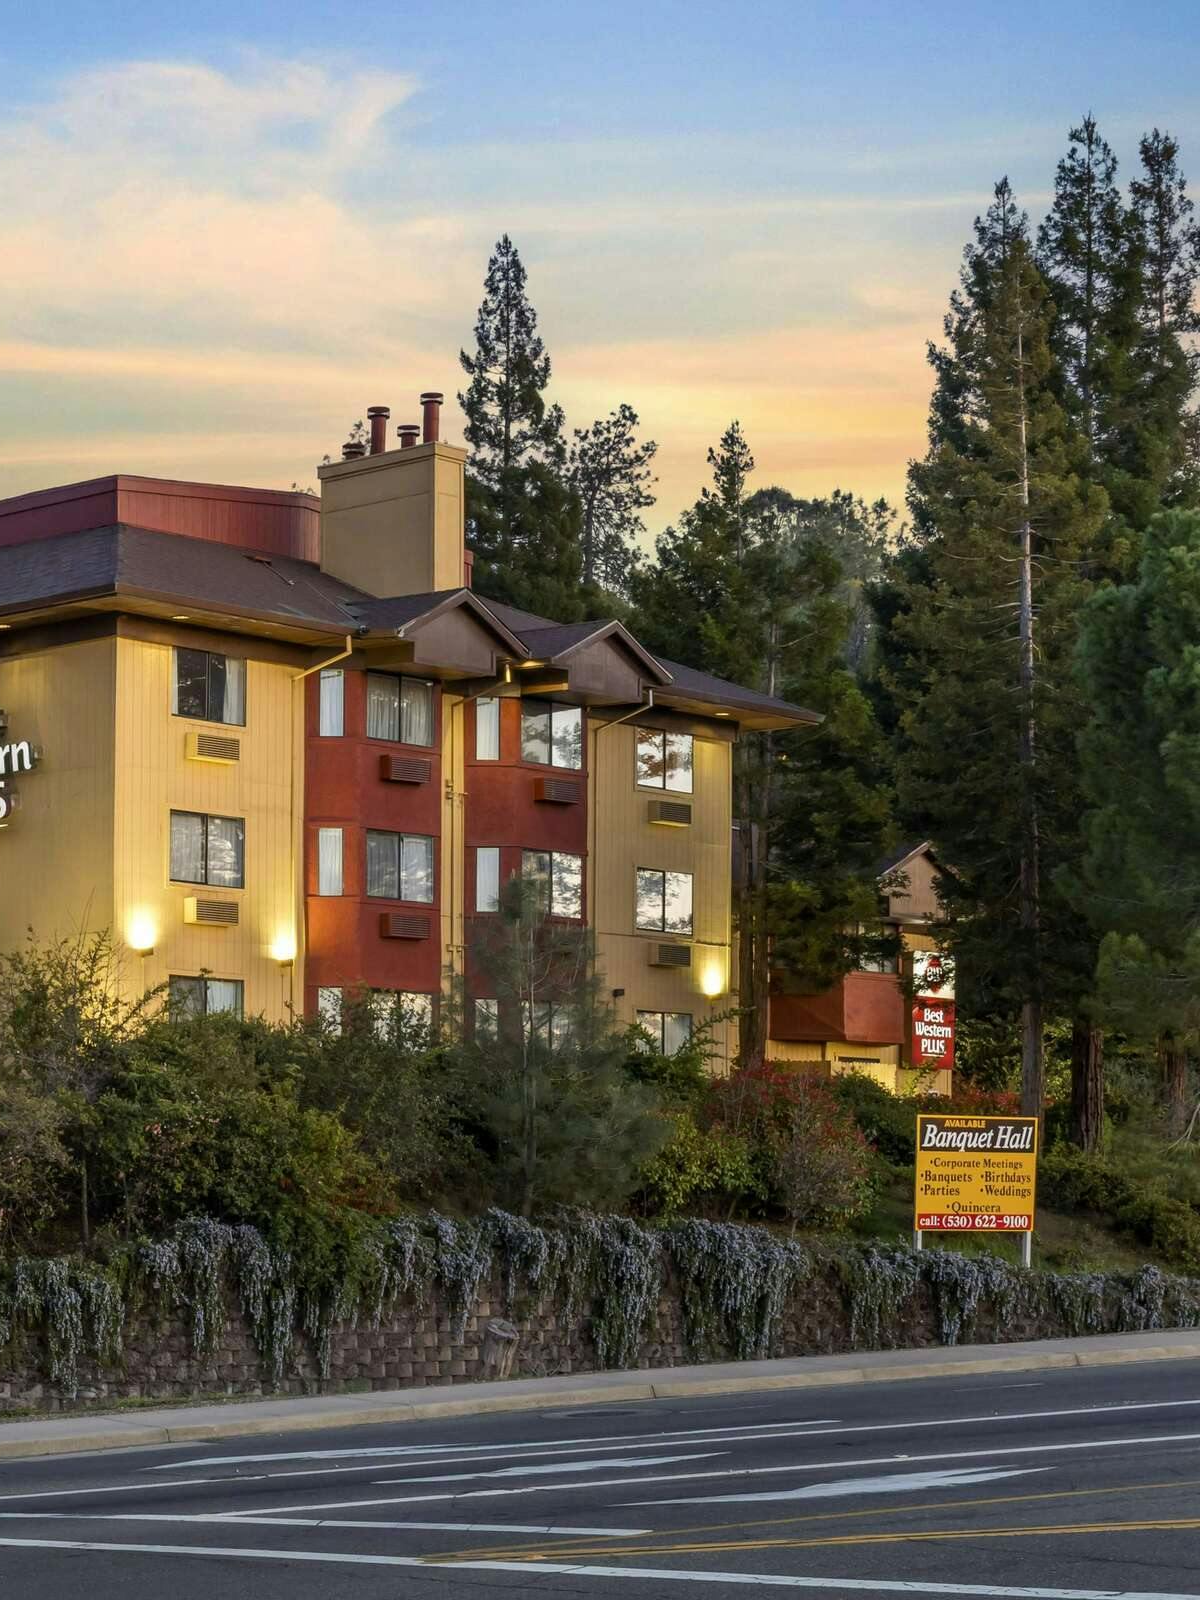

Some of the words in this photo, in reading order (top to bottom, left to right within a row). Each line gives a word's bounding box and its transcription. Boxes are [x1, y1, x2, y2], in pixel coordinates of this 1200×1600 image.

[923, 1007, 944, 1023] Best
[915, 1021, 952, 1038] Western
[921, 1038, 945, 1054] PLUS
[944, 1119, 987, 1128] AVAILABLE
[922, 1124, 994, 1152] Banquet
[994, 1126, 1033, 1149] Hall
[934, 1158, 980, 1169] Corporate
[983, 1159, 1023, 1169] Meetings
[924, 1170, 973, 1184] Banquets
[985, 1171, 1031, 1185] Birthdays
[924, 1184, 960, 1196] Parties
[985, 1185, 1032, 1199] Weddings
[951, 1201, 1001, 1215] Quincera
[920, 1215, 940, 1226] call:
[942, 1215, 972, 1228] (530)
[974, 1215, 1028, 1228] 622-9100
